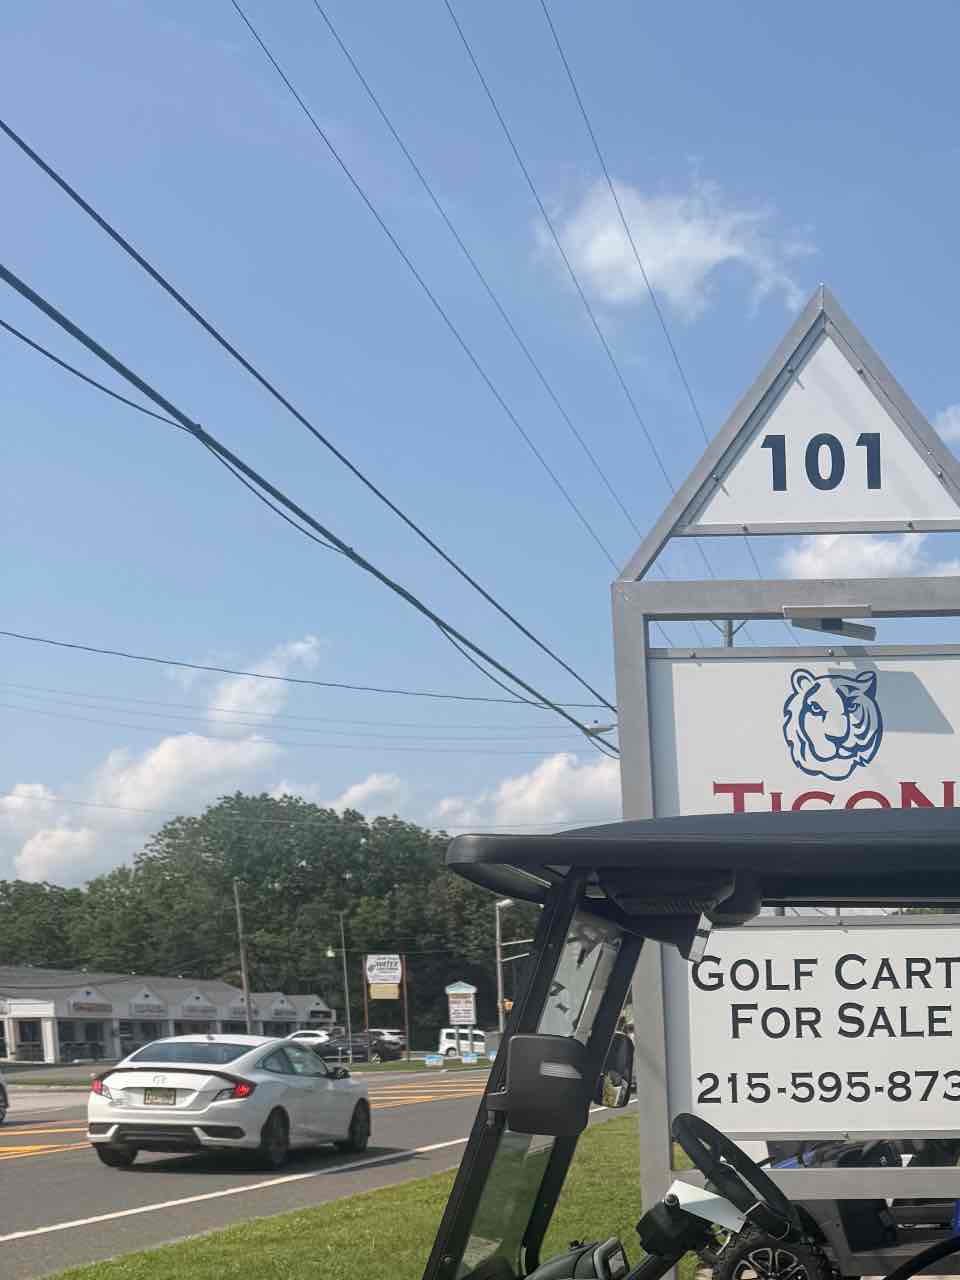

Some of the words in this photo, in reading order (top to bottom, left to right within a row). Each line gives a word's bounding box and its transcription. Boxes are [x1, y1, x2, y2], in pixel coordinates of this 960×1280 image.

[760, 432, 882, 491] 101
[691, 955, 819, 991] GOLF
[730, 1003, 823, 1039] FOR
[837, 1002, 953, 1038] SALE
